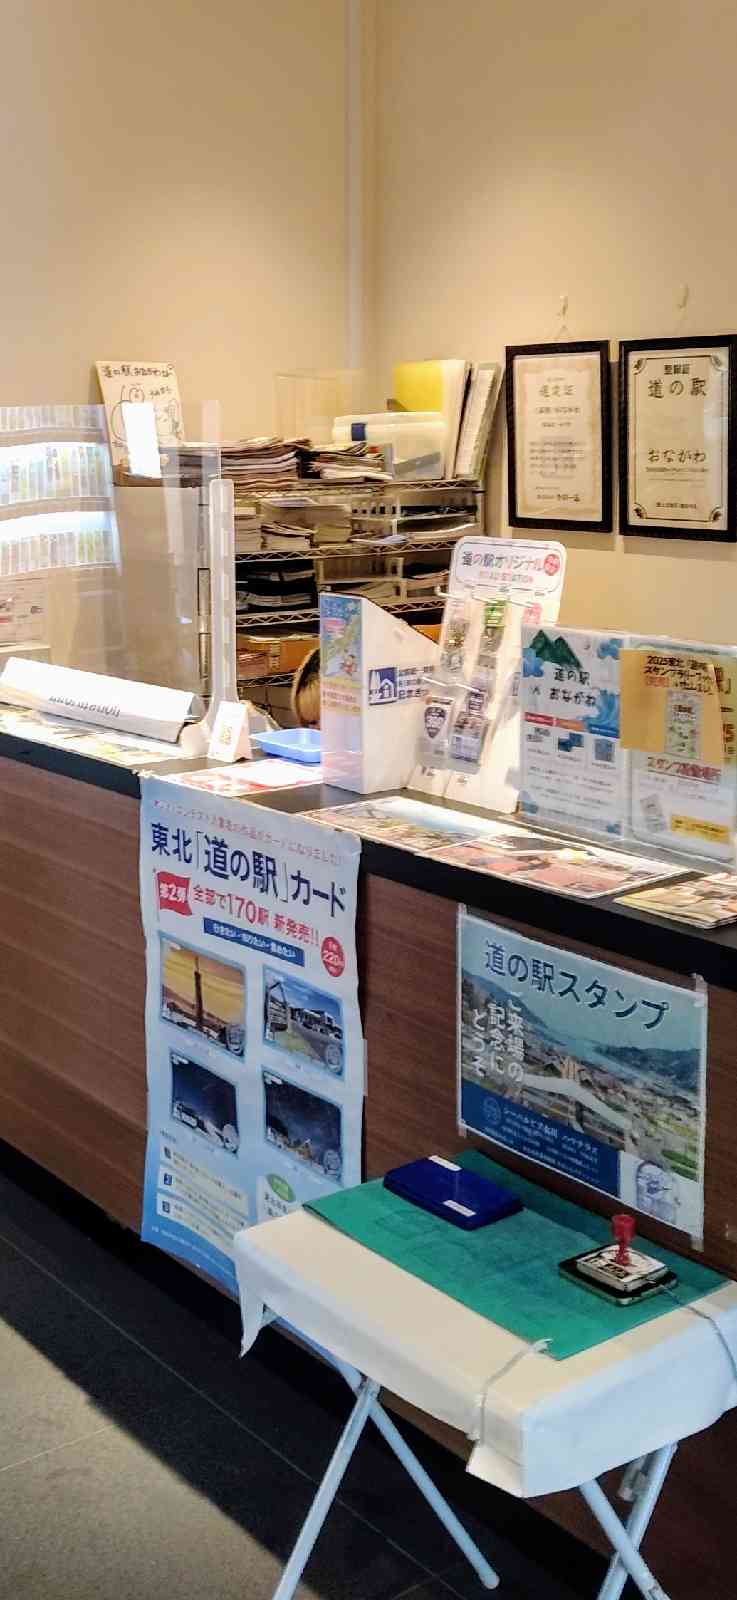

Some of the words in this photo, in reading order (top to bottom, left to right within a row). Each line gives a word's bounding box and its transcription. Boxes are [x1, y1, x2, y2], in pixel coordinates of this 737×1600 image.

[648, 377, 706, 399] 道の駅
[648, 448, 706, 464] おながわ
[151, 823, 346, 917] 東北「道の駅」カード
[193, 885, 269, 924] 全部で170駅
[485, 939, 670, 1029] 道の駅スタンプ
[472, 1008, 487, 1077] どうぞ
[488, 1002, 506, 1074] 記念に
